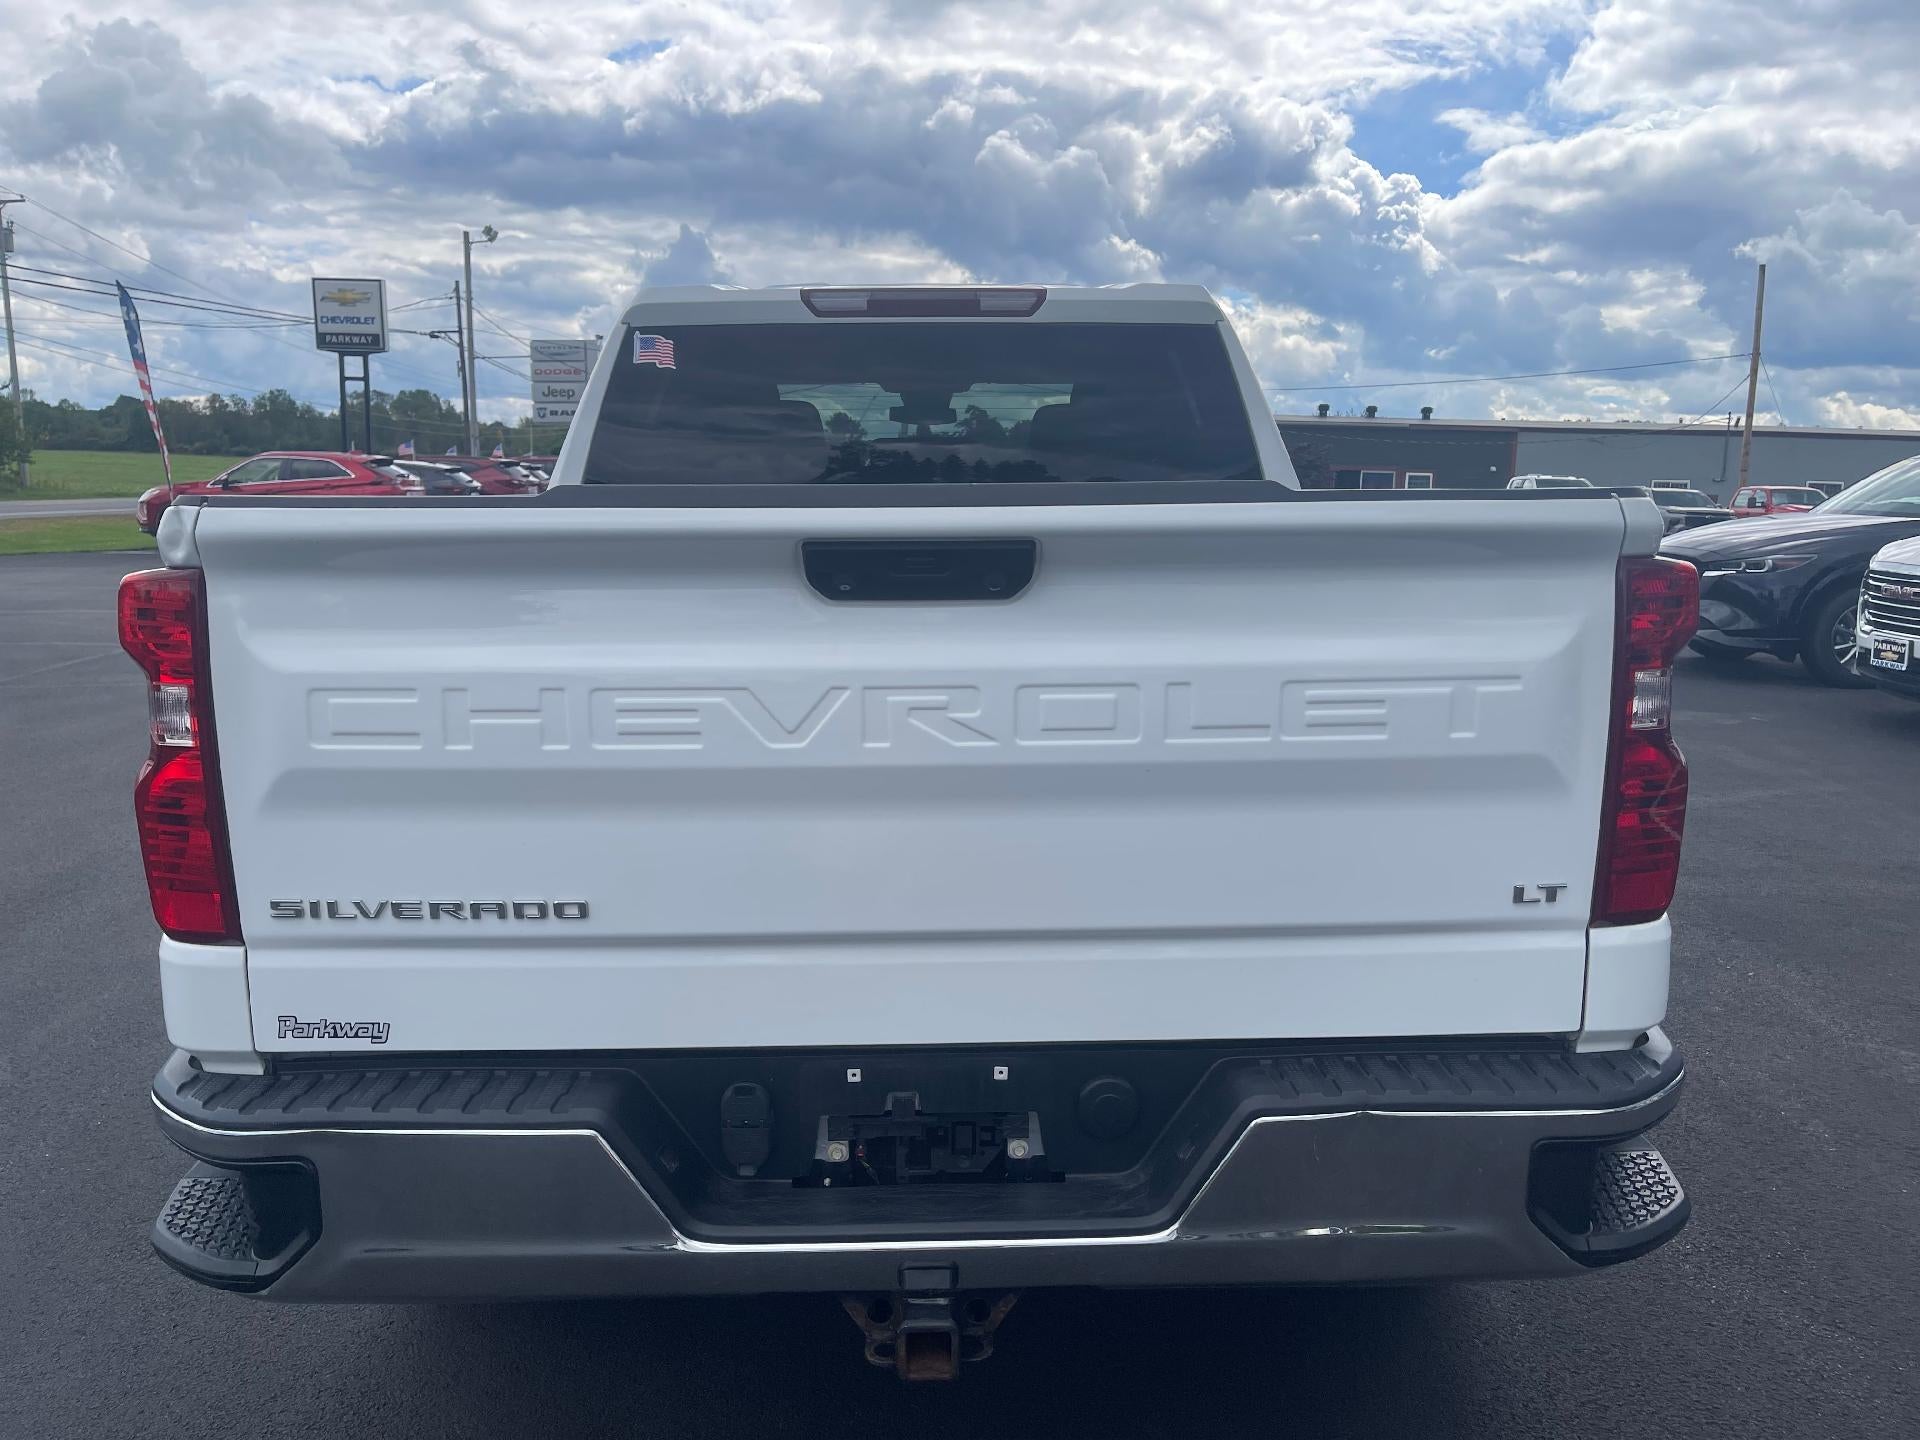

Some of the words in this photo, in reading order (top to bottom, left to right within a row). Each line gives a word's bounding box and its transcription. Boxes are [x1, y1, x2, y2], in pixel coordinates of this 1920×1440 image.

[320, 315, 376, 325] CHEVROLET
[326, 335, 373, 344] PARKWAY
[534, 368, 582, 376] DODGE
[542, 385, 576, 400] Jeep
[1881, 584, 1920, 600] GMC
[1874, 641, 1907, 654] PARKWAY
[1872, 660, 1906, 670] PARKWAY
[307, 675, 1522, 750] CHEVROLET
[1512, 883, 1568, 904] LT
[270, 899, 590, 920] SILVERADO
[277, 1015, 390, 1044] Parkway
